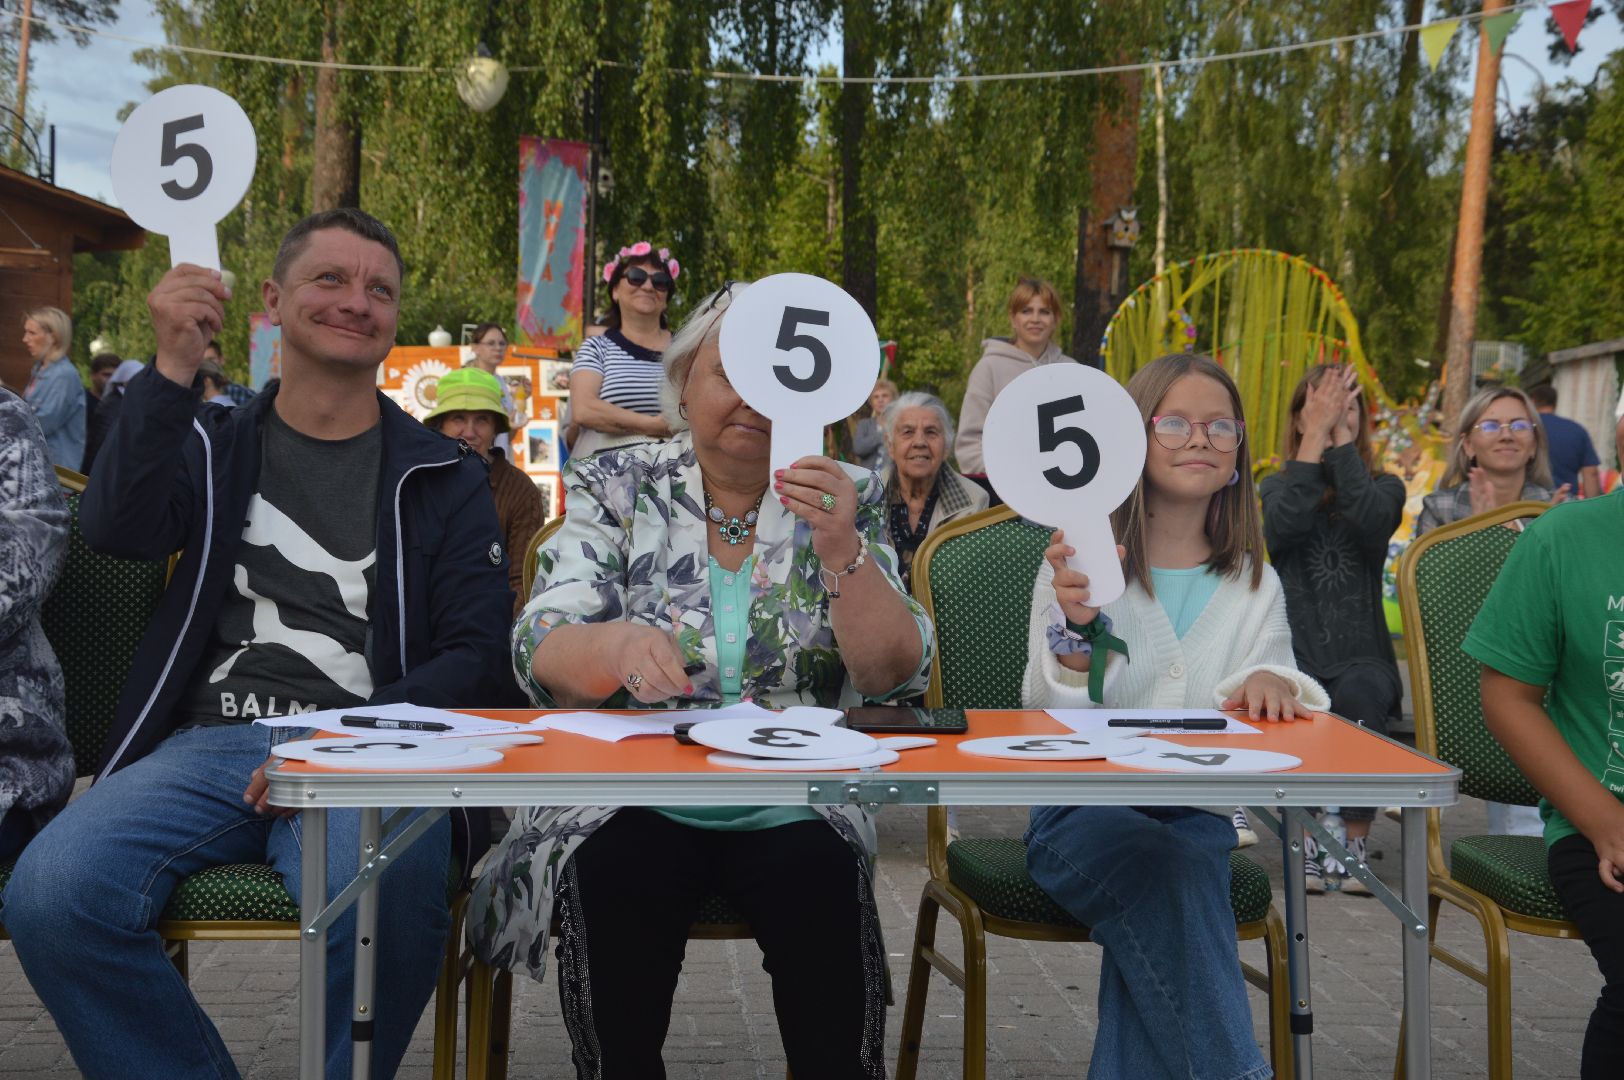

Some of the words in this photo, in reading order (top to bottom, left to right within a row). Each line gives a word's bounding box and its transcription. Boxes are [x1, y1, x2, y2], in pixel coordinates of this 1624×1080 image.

[160, 114, 214, 201] 5
[773, 306, 832, 393] 5
[1037, 395, 1101, 491] 5
[220, 692, 318, 718] BALM
[312, 742, 419, 754] 3
[748, 727, 821, 748] 3
[1008, 739, 1091, 752] 3
[1155, 752, 1231, 766] 4
